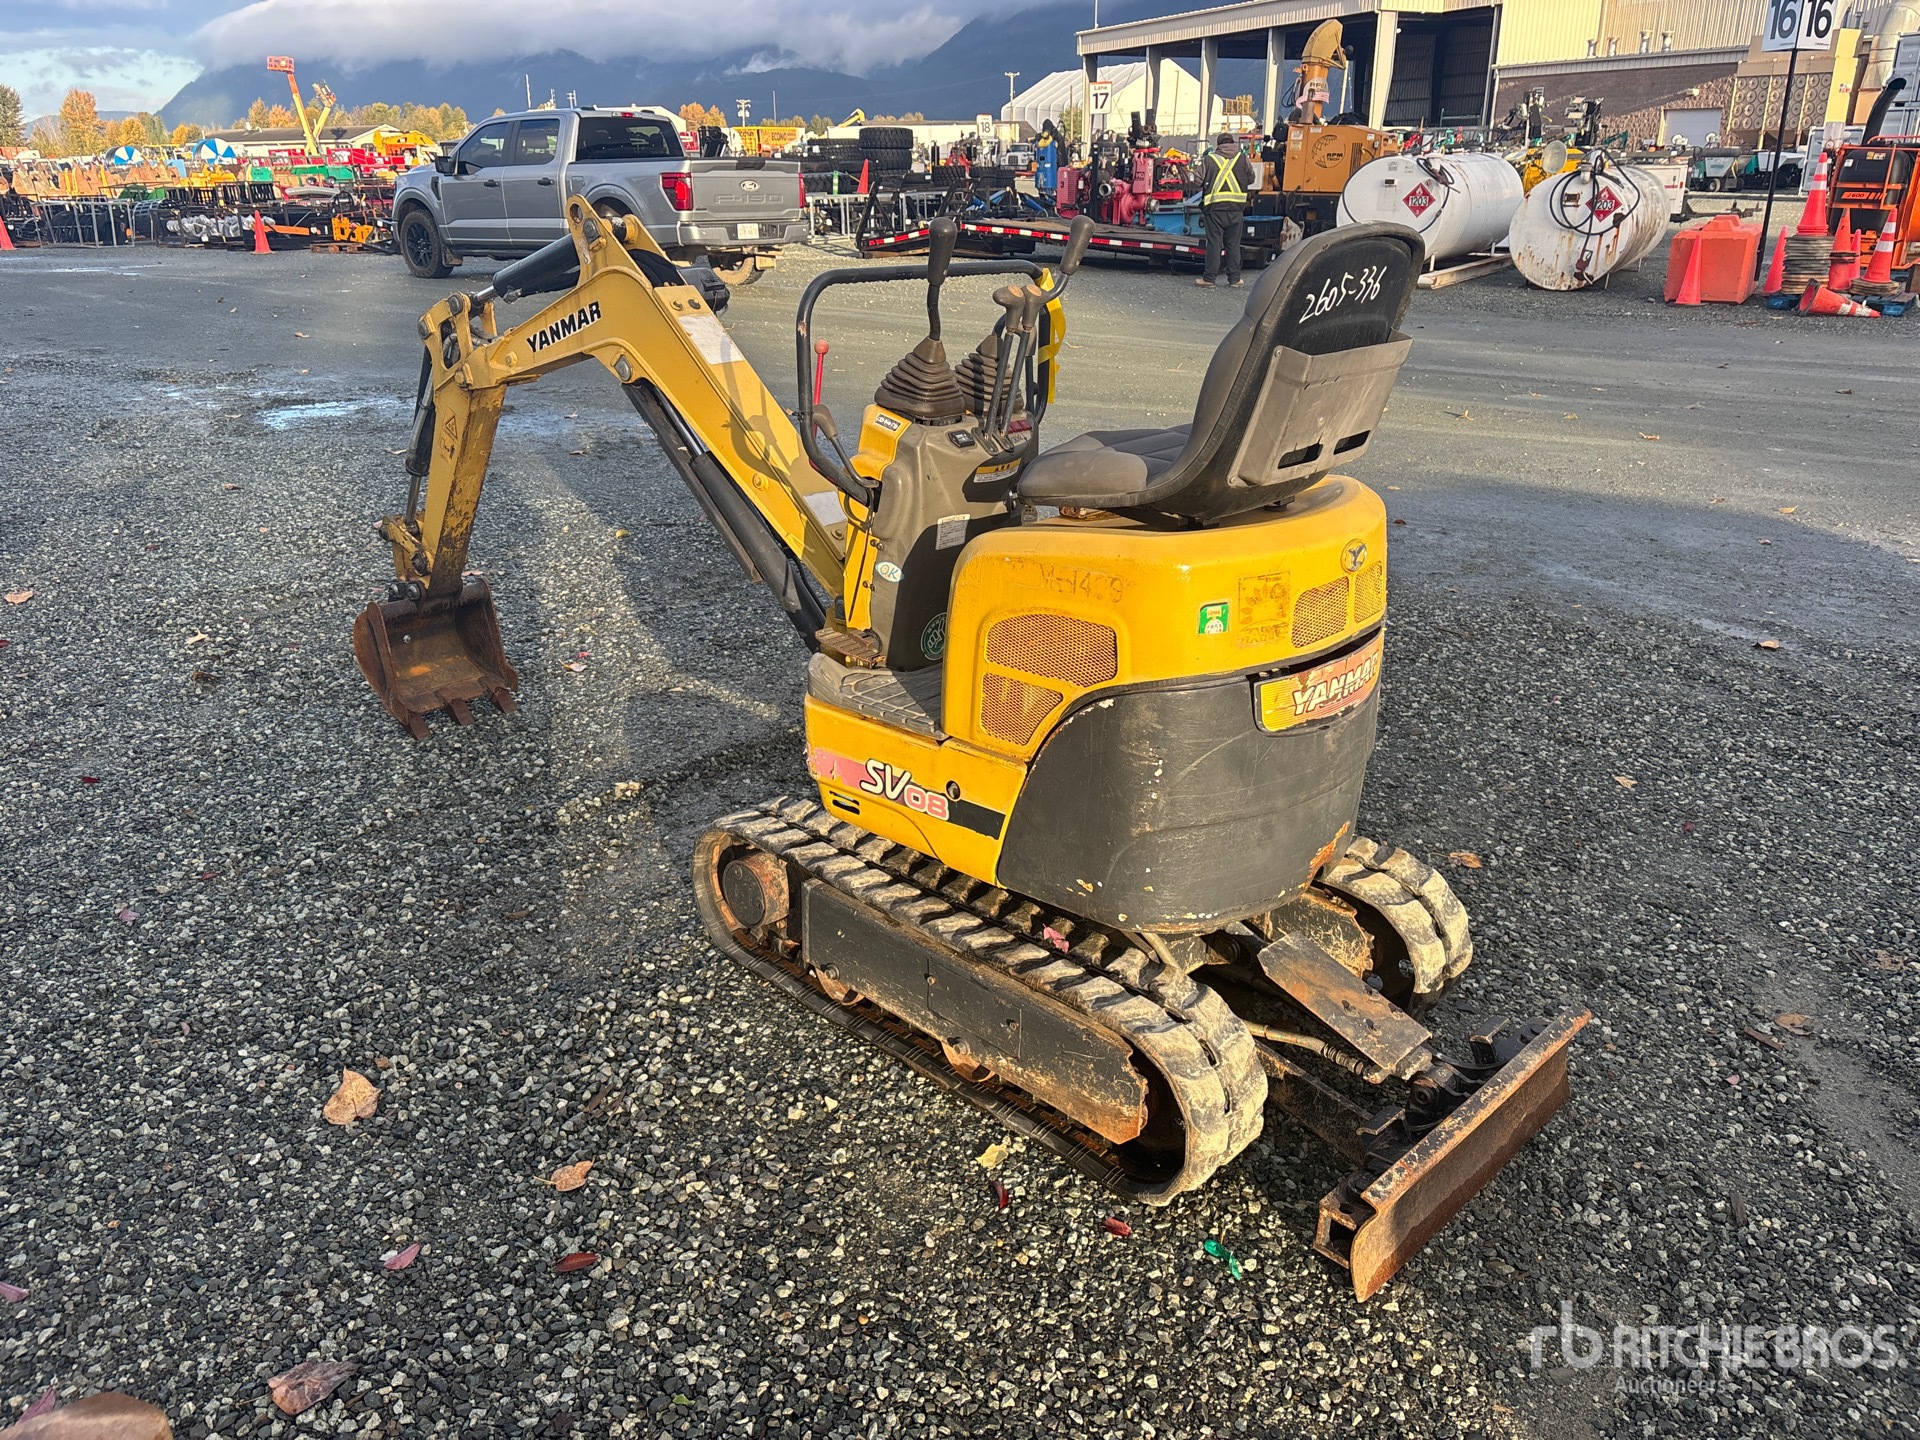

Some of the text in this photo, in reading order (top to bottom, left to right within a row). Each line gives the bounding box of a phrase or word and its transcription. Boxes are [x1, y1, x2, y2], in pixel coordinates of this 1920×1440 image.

[1769, 0, 1798, 40] 16
[1805, 0, 1834, 39] 16
[1092, 92, 1110, 110] 17
[980, 121, 991, 134] 18
[713, 194, 784, 205] F-150
[1409, 196, 1429, 206] 1203
[1298, 265, 1388, 325] 2605-336
[525, 301, 602, 353] YANMAR
[879, 563, 899, 581] OK
[1291, 649, 1379, 716] YANMAR
